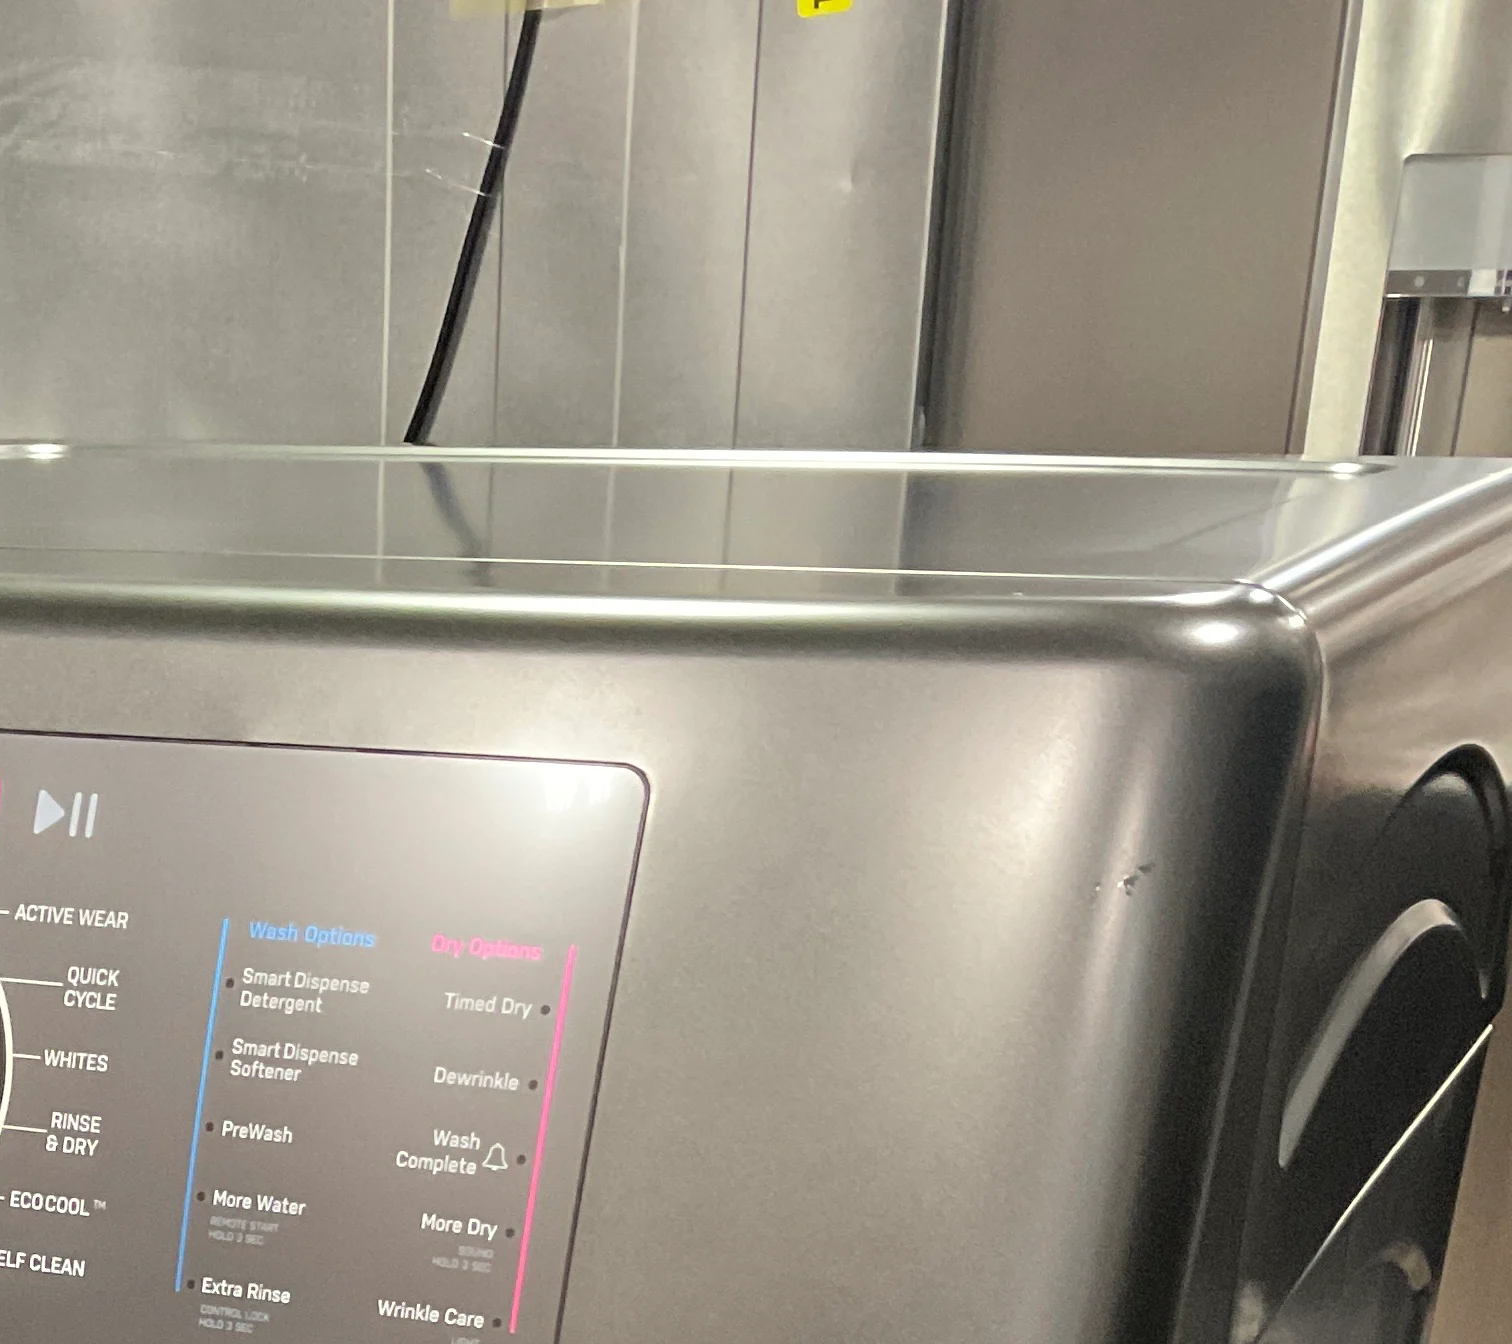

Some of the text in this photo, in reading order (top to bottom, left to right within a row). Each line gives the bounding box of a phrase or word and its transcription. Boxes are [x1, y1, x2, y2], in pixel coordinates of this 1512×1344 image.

[15, 904, 129, 930] ACTIVE WEAR
[249, 920, 376, 948] Wash Options
[431, 933, 543, 961] Dry Options
[67, 967, 120, 990] QUICK
[63, 990, 117, 1012] CYCLE
[240, 990, 323, 1015] Detergent
[444, 992, 532, 1020] Timed Dry
[44, 1050, 109, 1073] WHITES
[230, 1059, 302, 1082] Softener
[434, 1066, 520, 1091] Dewrinkle
[50, 1112, 102, 1135] RINSE
[221, 1119, 293, 1144] PreWash
[46, 1134, 100, 1158] & DRY
[433, 1129, 481, 1151] Wash
[396, 1150, 478, 1176] Complete
[213, 1190, 307, 1216] More Water
[208, 1230, 233, 1243] HOLD
[210, 1216, 279, 1233] REMOTE START
[421, 1213, 498, 1241] More Dry
[29, 1253, 86, 1278] CLEAN
[201, 1276, 291, 1304] Extra Rinse
[198, 1318, 223, 1331] HOLD
[377, 1299, 485, 1329] Wrinkle Care
